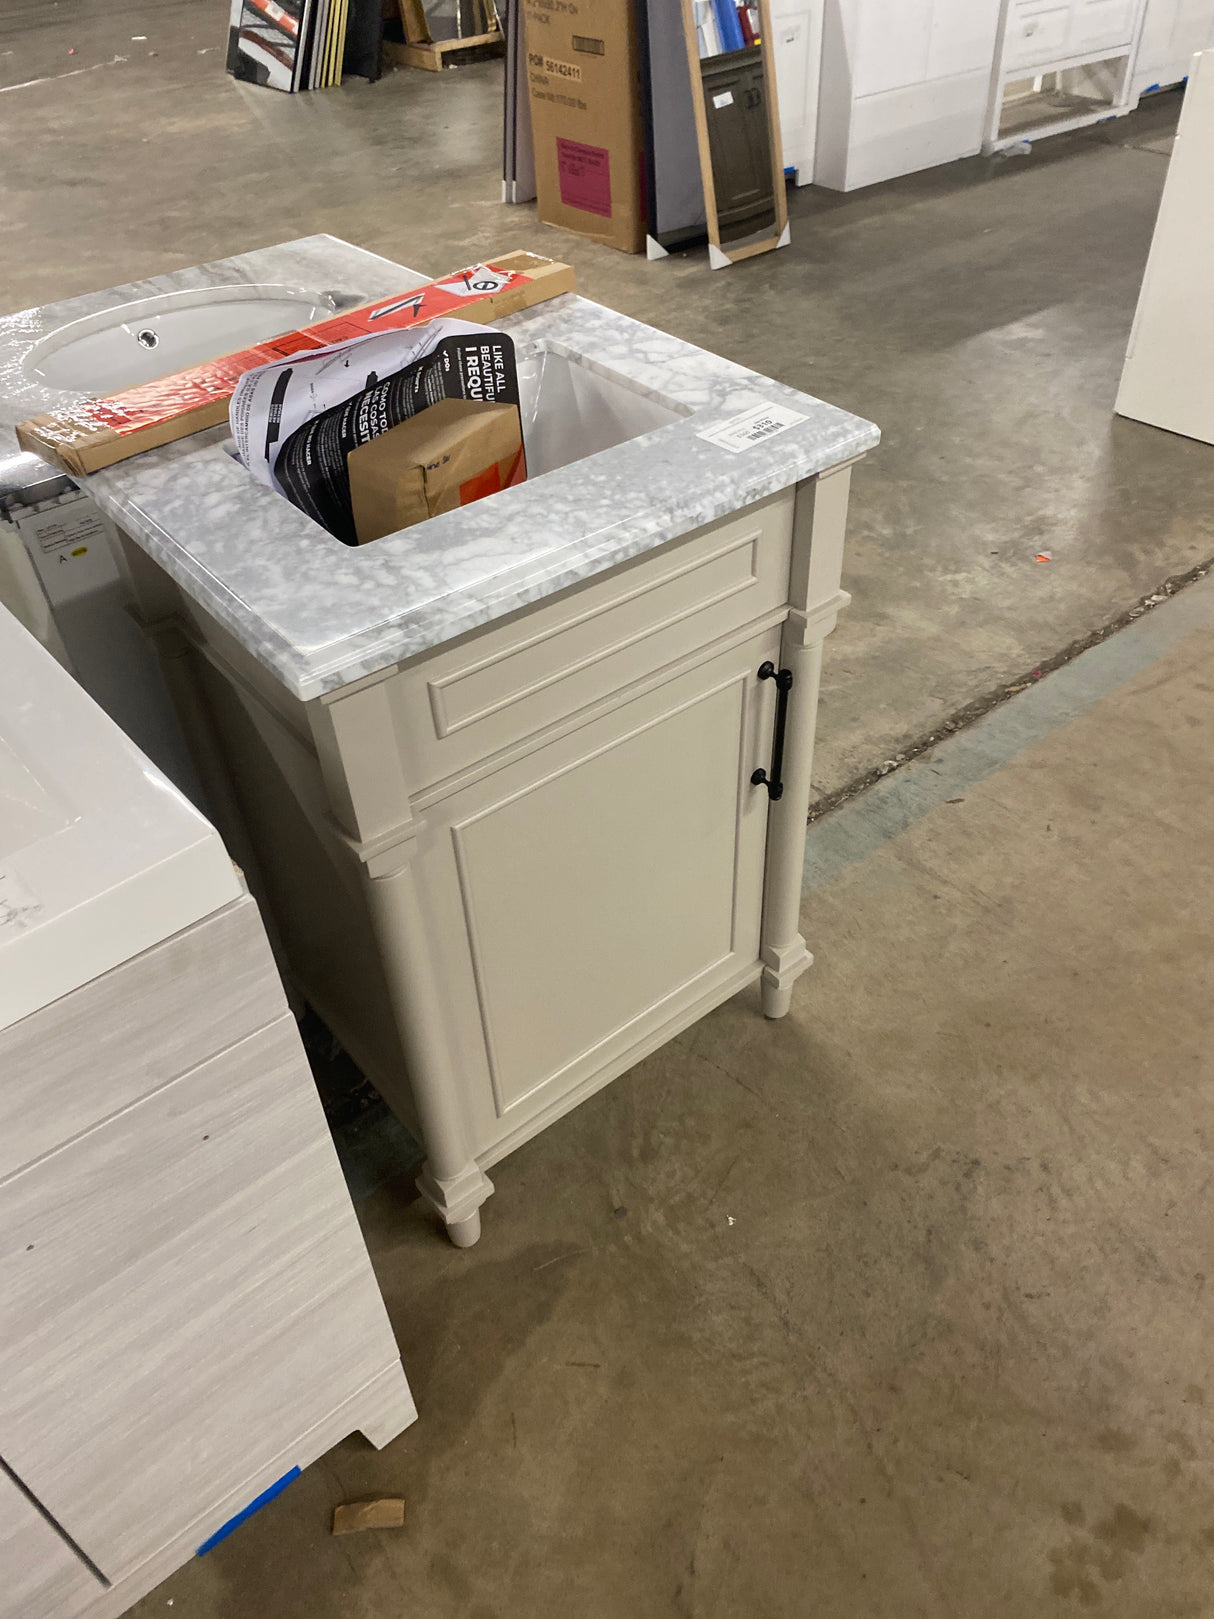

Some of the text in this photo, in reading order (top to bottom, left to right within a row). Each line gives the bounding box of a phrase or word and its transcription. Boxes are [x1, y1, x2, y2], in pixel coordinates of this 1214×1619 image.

[492, 345, 506, 393] LIKE ALL
[371, 385, 382, 403] LAS
[378, 381, 390, 411] COMO
